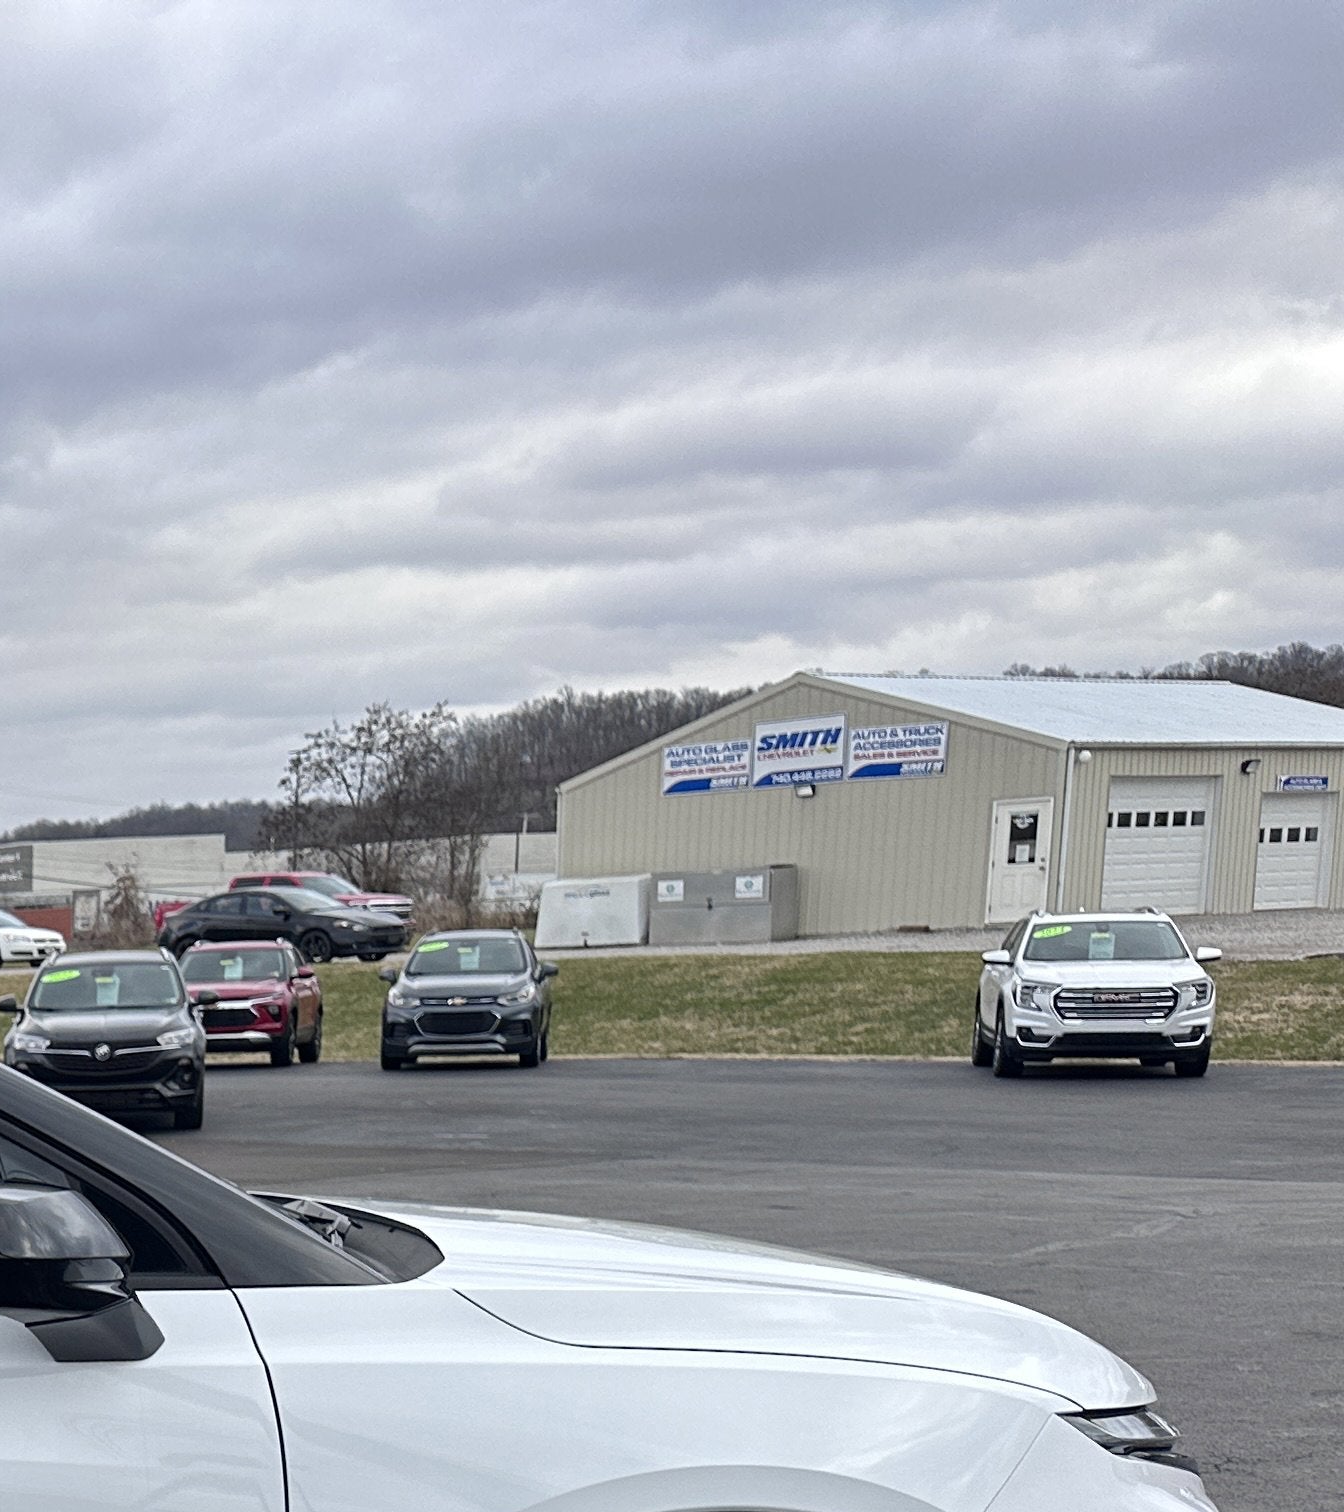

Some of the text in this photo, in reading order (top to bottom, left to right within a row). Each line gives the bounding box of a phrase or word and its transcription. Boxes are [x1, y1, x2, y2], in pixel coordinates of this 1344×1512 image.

[758, 726, 842, 752] SMITH
[853, 729, 887, 740] AUTO
[902, 724, 944, 737] TRUCK
[666, 742, 749, 759] AUTO GLASS
[854, 737, 941, 751] ACCESSORIES
